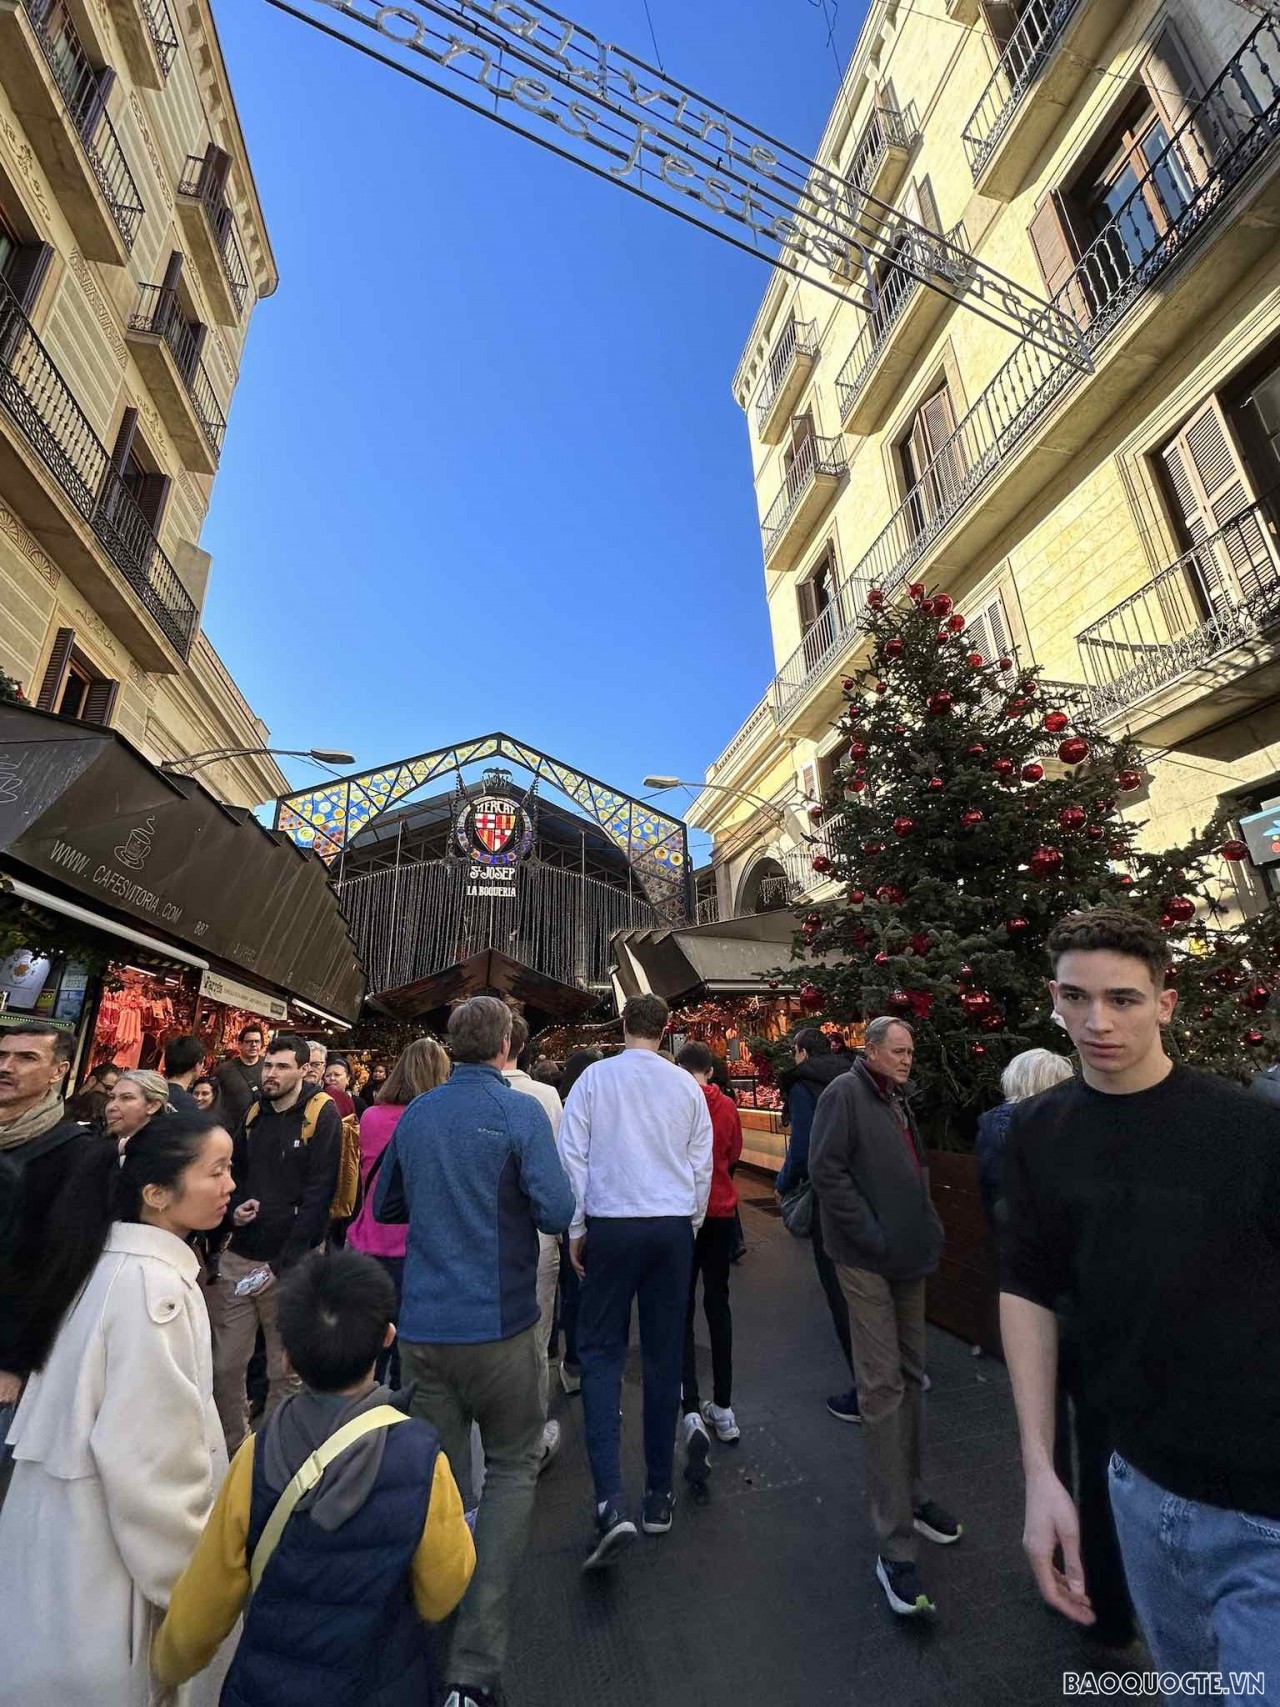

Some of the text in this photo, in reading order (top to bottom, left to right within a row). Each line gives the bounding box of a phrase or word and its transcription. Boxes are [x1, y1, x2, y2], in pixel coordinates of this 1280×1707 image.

[318, 0, 606, 140] ones
[476, 800, 516, 814] MERCAT
[480, 867, 516, 880] JOSEP
[467, 885, 517, 897] LA BOQUERIA
